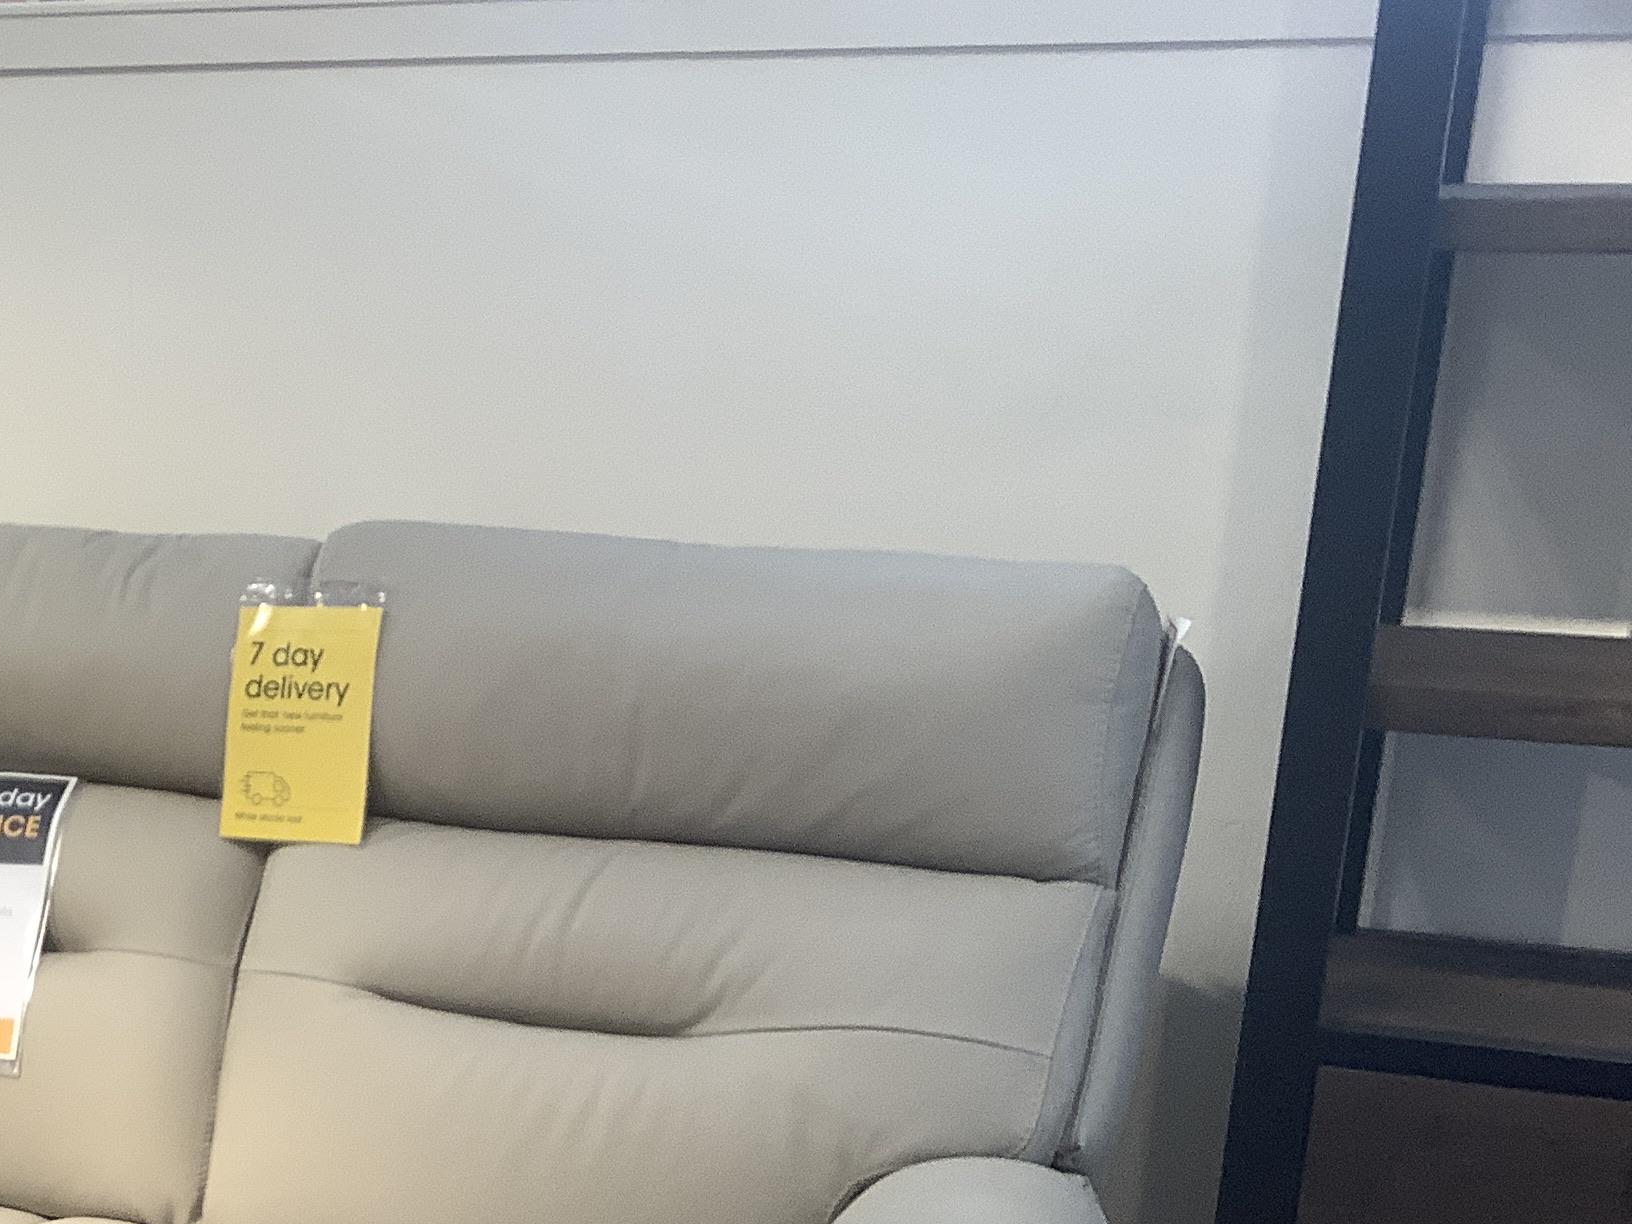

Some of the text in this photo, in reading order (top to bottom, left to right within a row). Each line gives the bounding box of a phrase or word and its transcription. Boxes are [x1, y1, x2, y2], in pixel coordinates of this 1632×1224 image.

[249, 641, 325, 673] 7 day
[245, 675, 350, 708] delivery
